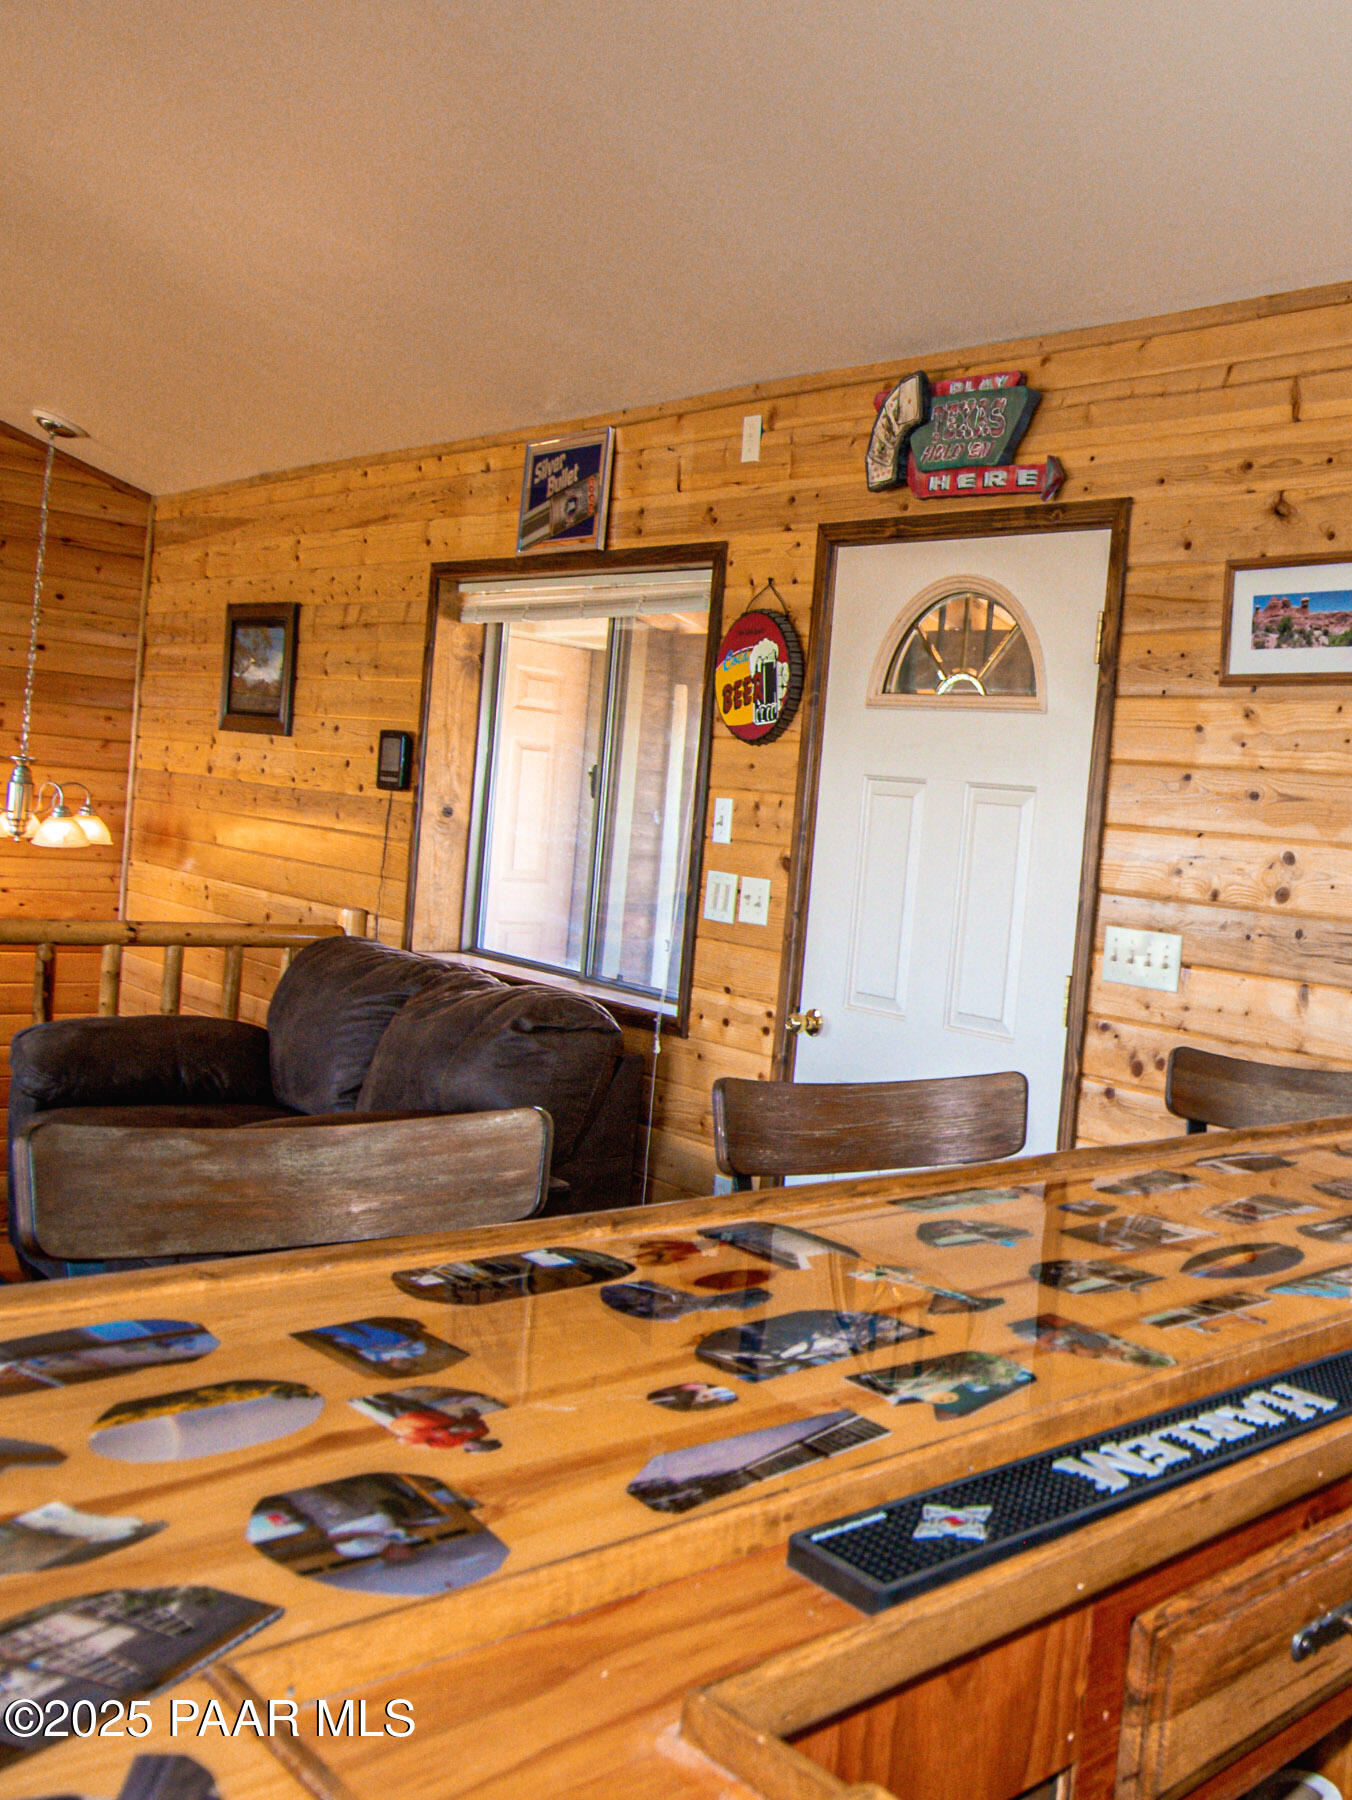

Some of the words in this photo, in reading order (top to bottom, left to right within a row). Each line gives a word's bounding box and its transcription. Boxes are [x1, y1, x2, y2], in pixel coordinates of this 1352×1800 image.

[949, 374, 1010, 395] PLAY
[930, 397, 1008, 444] TEXAS
[533, 452, 567, 485] Silver
[920, 442, 965, 463] HOLD
[546, 462, 580, 499] Bullet
[928, 468, 1039, 492] HERE
[722, 671, 764, 715] BEER
[1050, 1382, 1339, 1494] HARLEM
